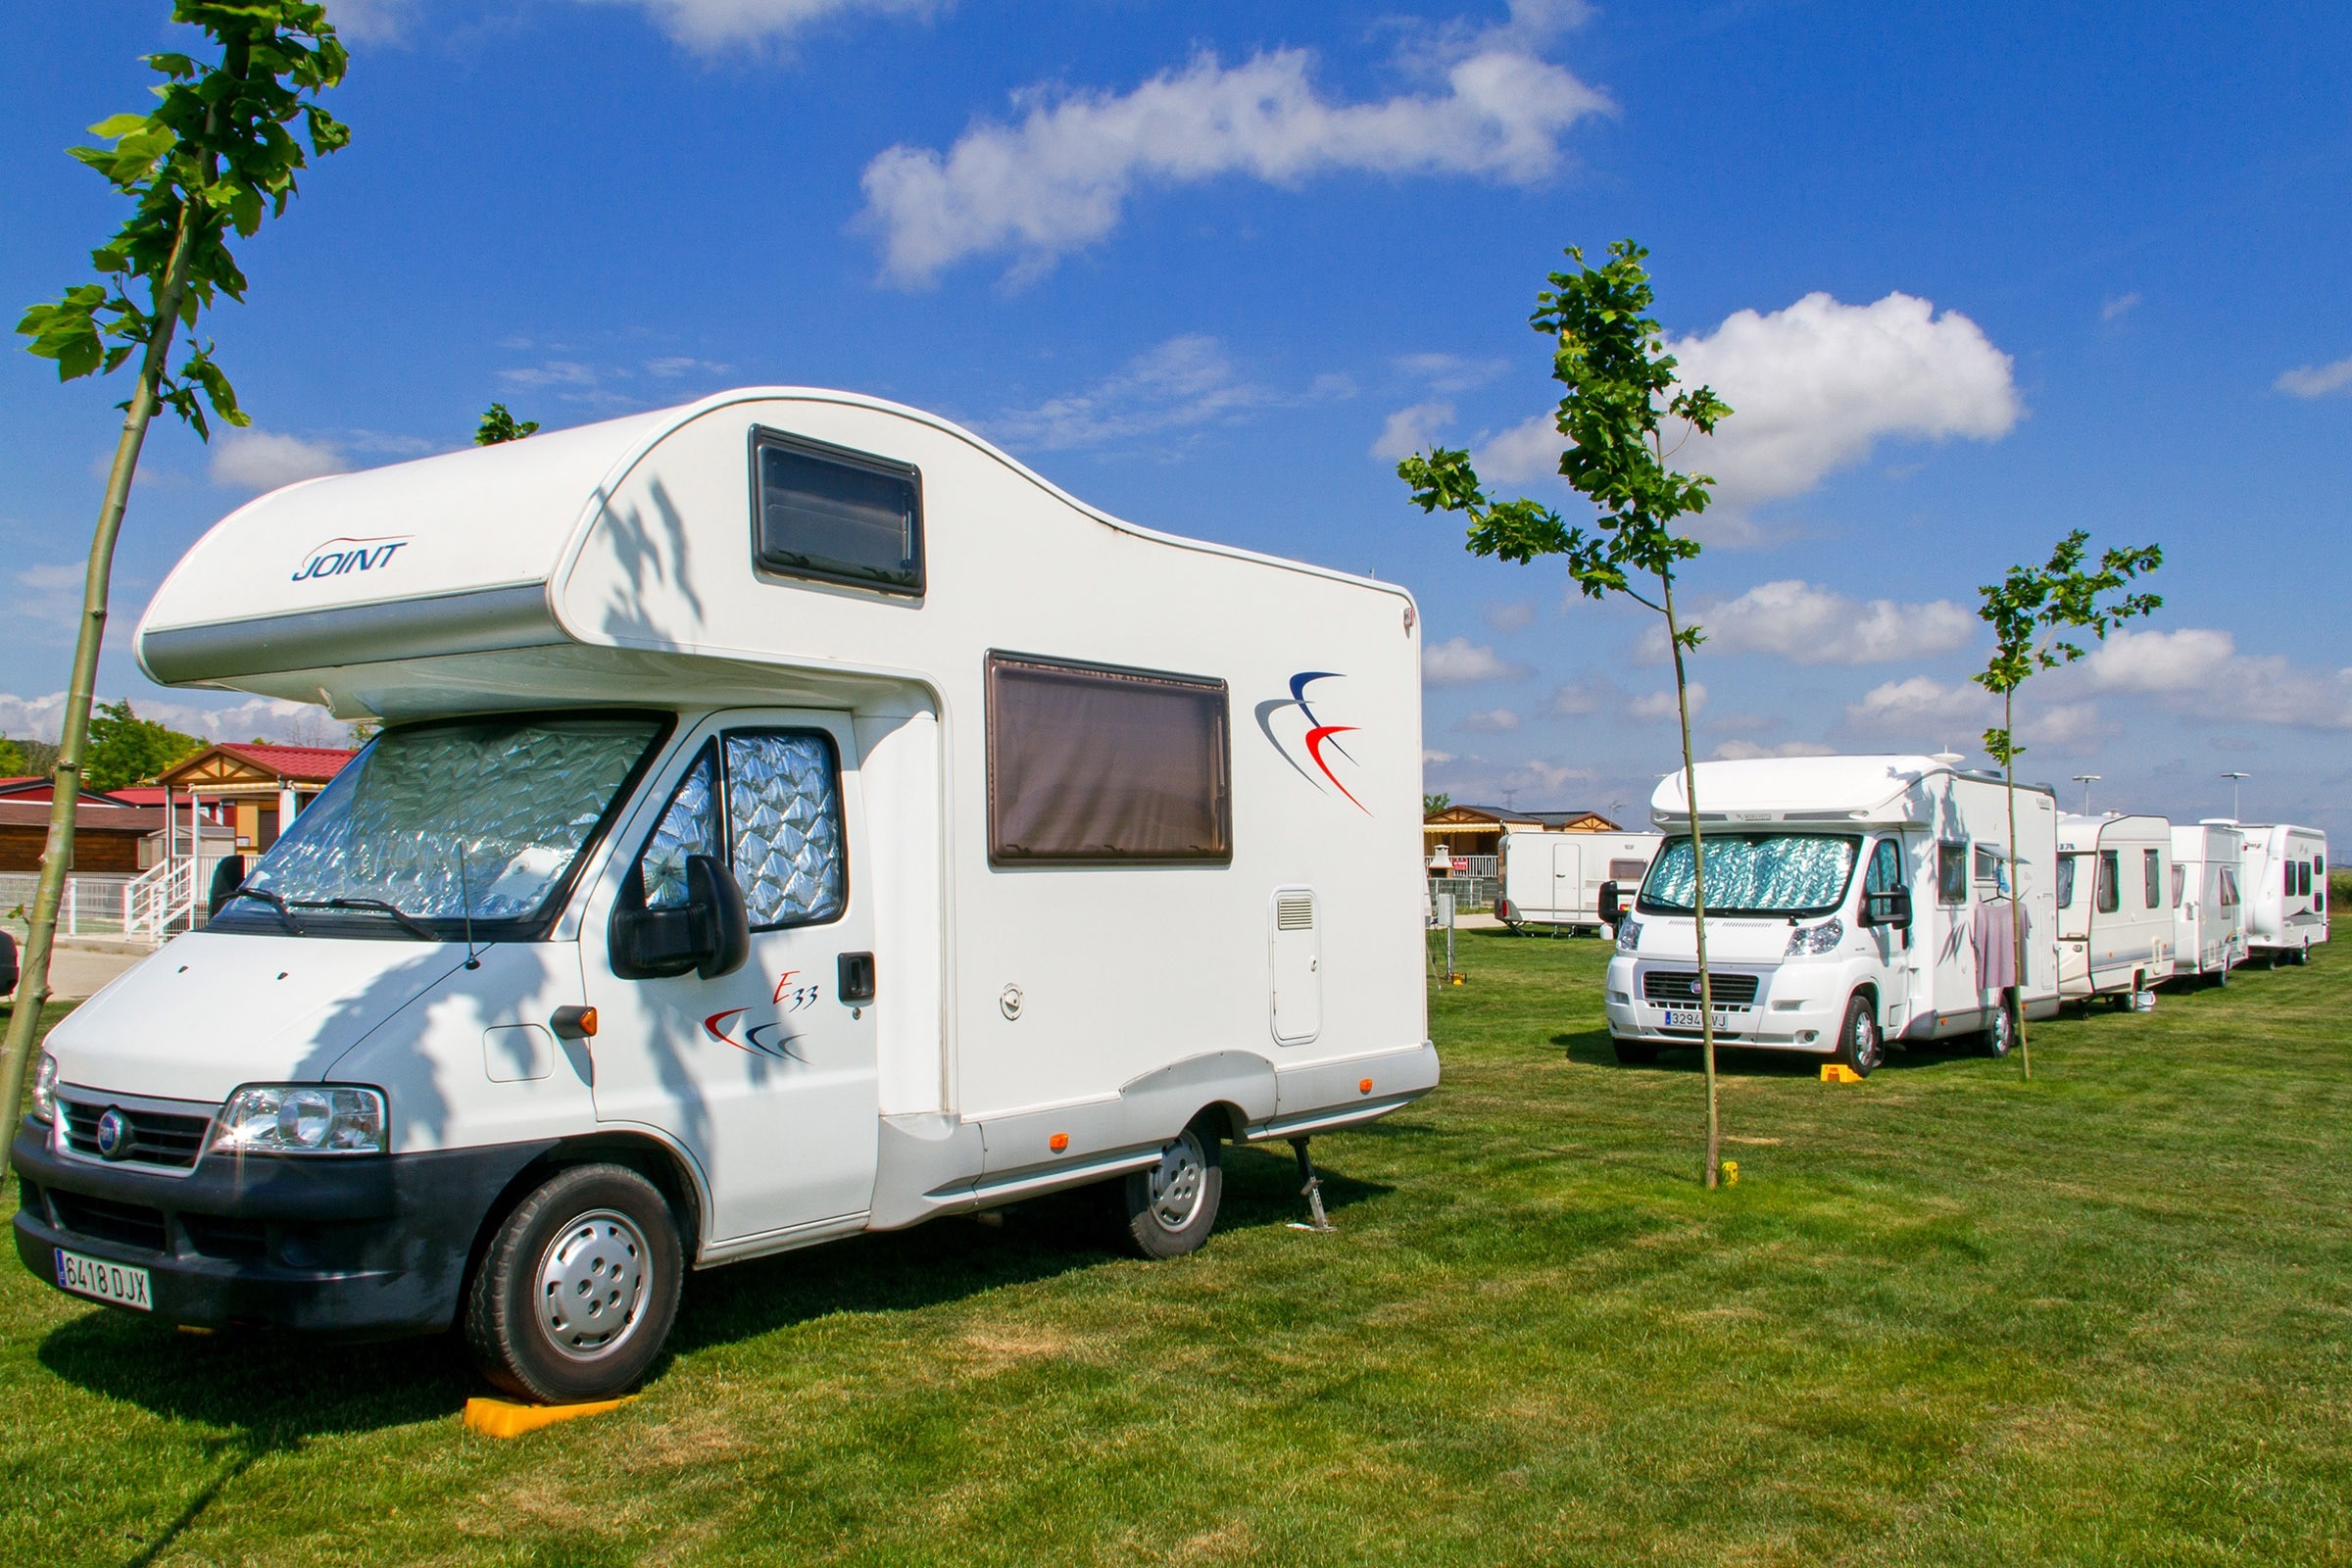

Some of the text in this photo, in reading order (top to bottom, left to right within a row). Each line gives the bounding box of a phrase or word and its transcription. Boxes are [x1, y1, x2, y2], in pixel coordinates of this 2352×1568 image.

[290, 541, 409, 582] JOINT
[772, 970, 819, 1013] E33
[1672, 1012, 1700, 1026] 3294
[66, 1256, 109, 1295] 6418
[112, 1267, 148, 1304] DJX
